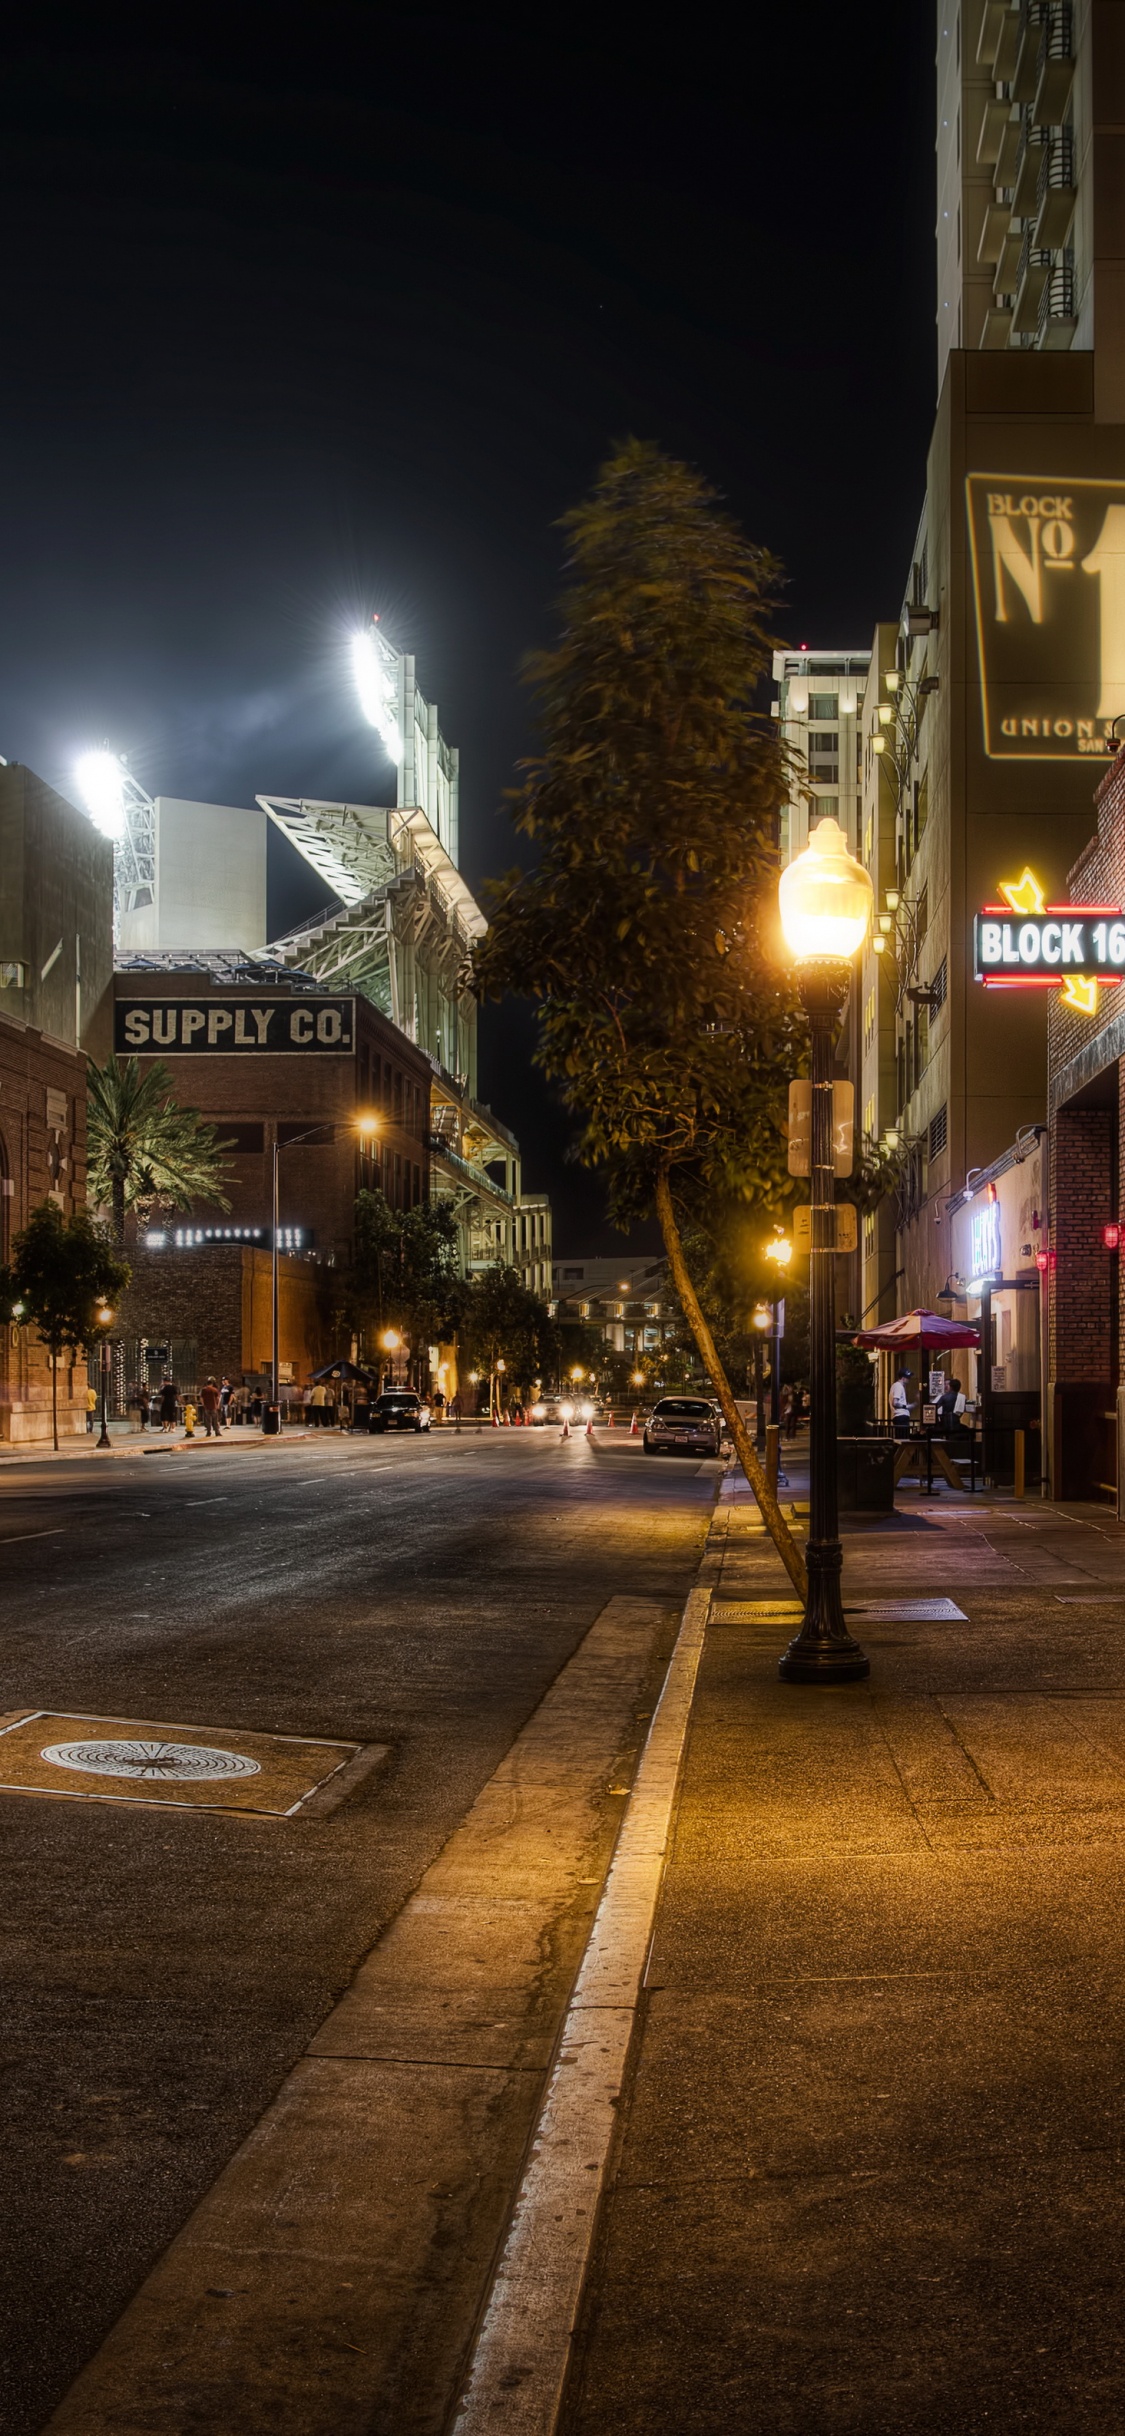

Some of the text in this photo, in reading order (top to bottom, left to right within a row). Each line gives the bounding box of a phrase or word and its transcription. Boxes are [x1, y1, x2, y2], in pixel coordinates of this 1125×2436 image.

[986, 493, 1073, 519] BLOCK
[1001, 718, 1093, 737] UNION
[1078, 739, 1104, 753] SAN
[981, 923, 1125, 963] BLOCK 16
[125, 1009, 351, 1044] SUPPLY CO.
